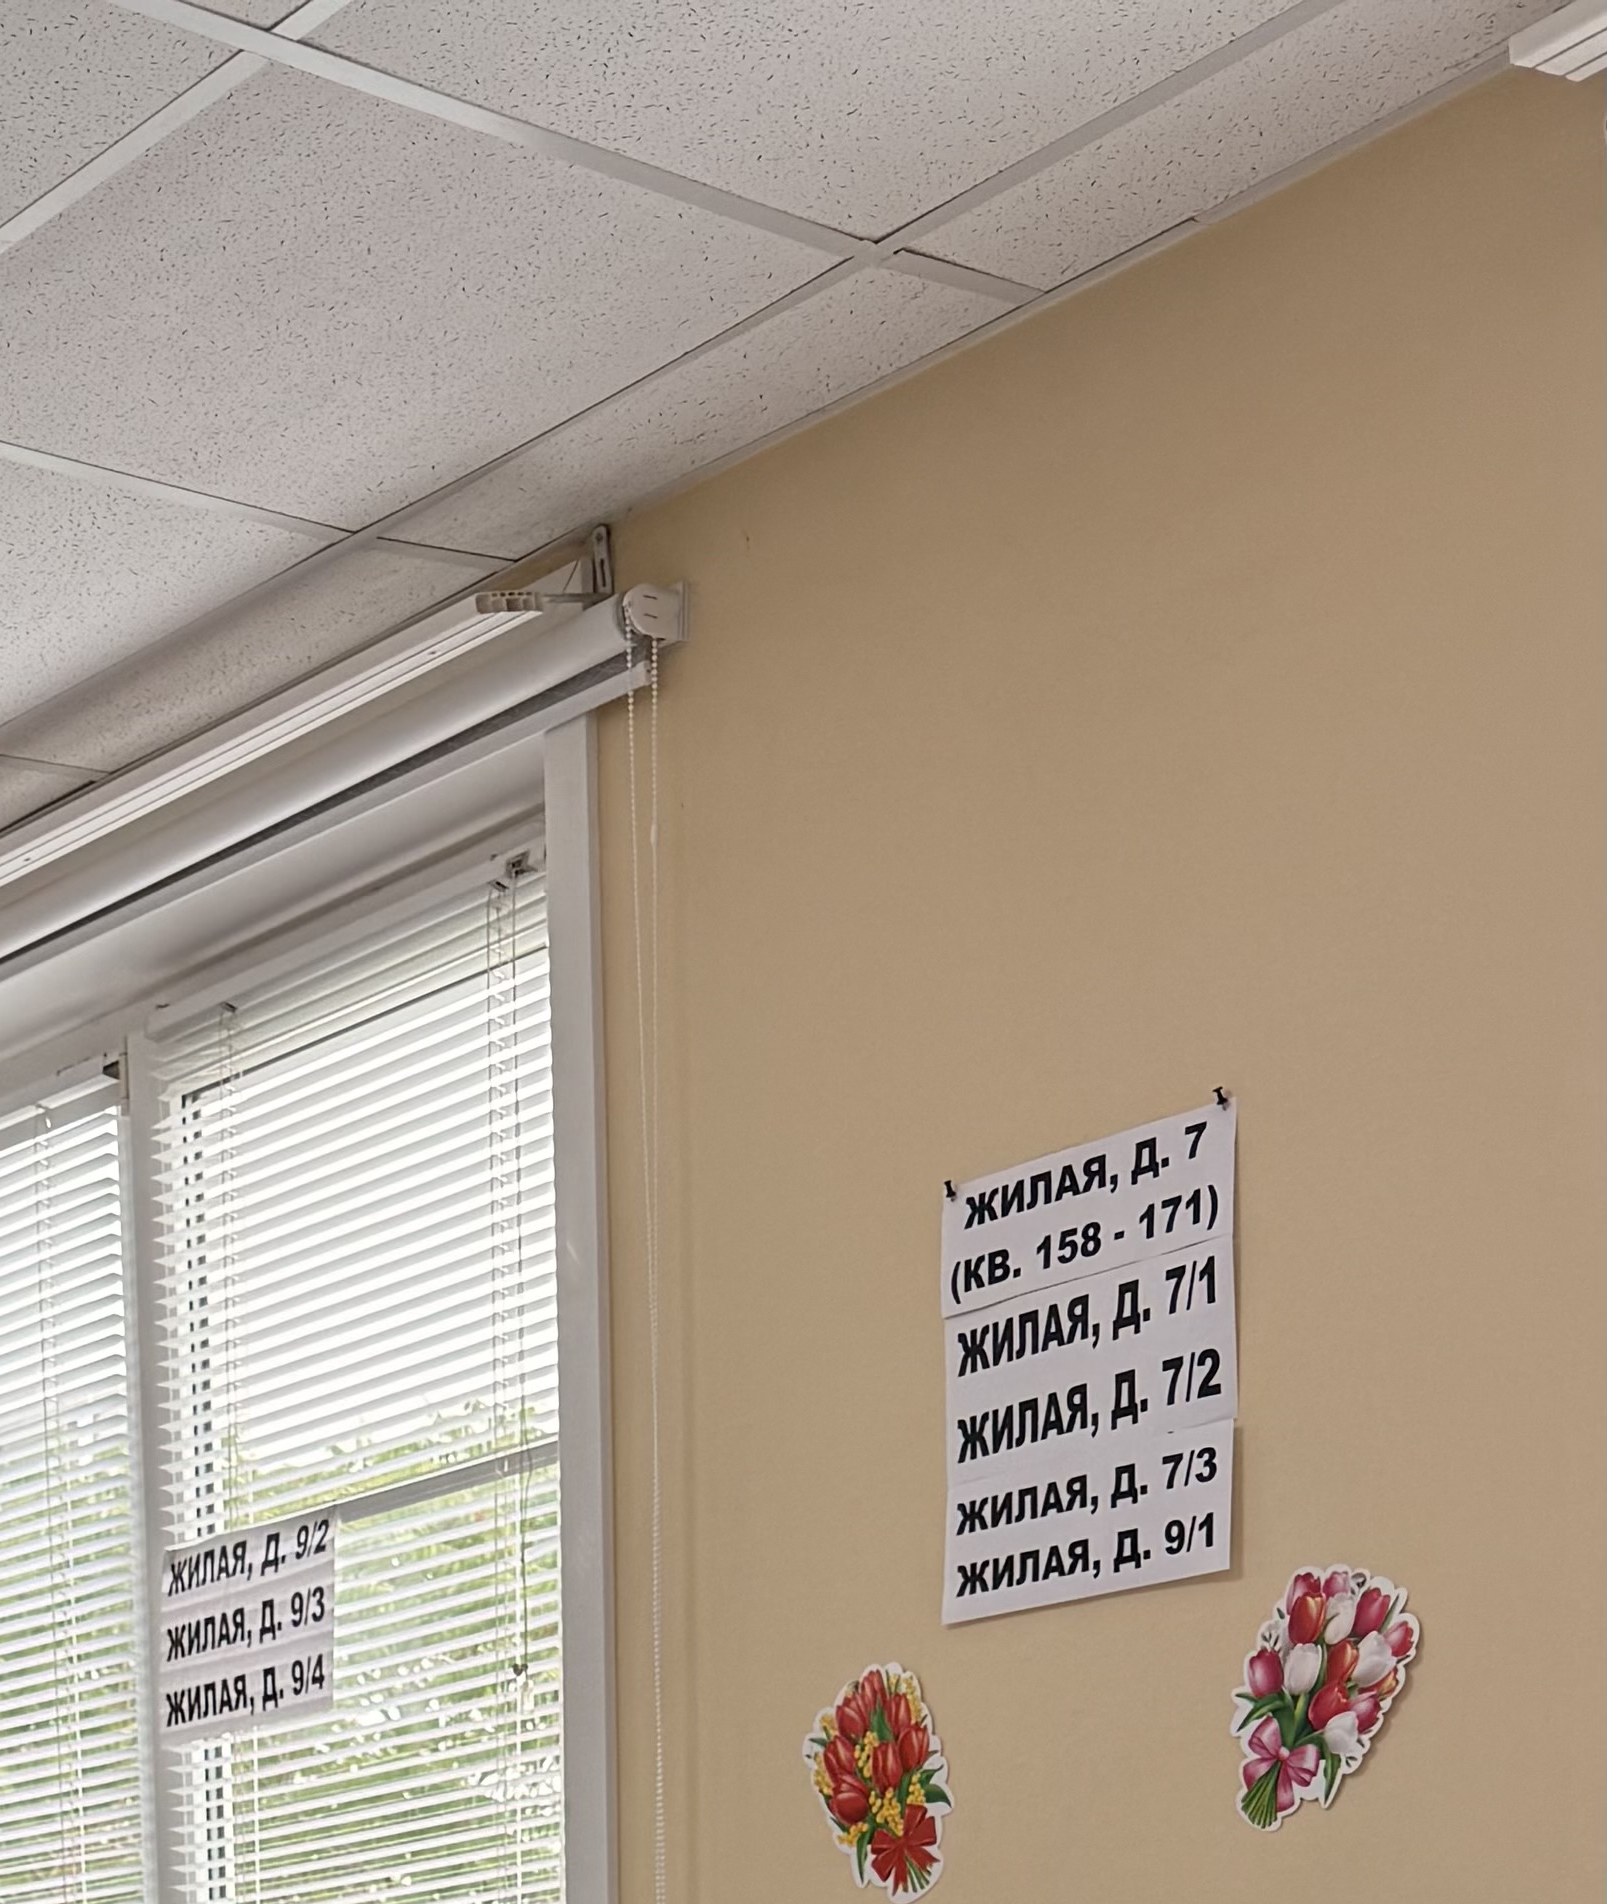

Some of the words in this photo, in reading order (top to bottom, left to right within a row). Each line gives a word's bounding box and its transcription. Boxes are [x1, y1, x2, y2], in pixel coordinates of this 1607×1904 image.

[964, 1153, 1119, 1230] ЖИЛАЯ,
[1130, 1136, 1170, 1186] Д.
[1184, 1121, 1208, 1160] 7
[951, 1248, 1022, 1305] (КВ.
[1036, 1221, 1102, 1270] 158
[1138, 1184, 1219, 1240] 171)
[957, 1293, 1101, 1378] ЖИЛАЯ,
[1112, 1279, 1151, 1341] Д.
[1165, 1255, 1216, 1315] 7/1
[957, 1383, 1099, 1464] ЖИЛАЯ,
[1110, 1368, 1148, 1431] Д.
[1162, 1348, 1222, 1406] 7/2
[956, 1474, 1099, 1536] ЖИЛАЯ,
[1110, 1463, 1148, 1509] Д.
[1161, 1446, 1218, 1490] 7/3
[167, 1540, 253, 1597] ЖИЛАЯ,
[260, 1532, 287, 1577] Д.
[295, 1518, 330, 1560] 9/2
[956, 1538, 1101, 1598] ЖИЛАЯ,
[1113, 1527, 1151, 1574] Д.
[1164, 1512, 1214, 1555] 9/1
[166, 1607, 252, 1662] ЖИЛАЯ,
[259, 1598, 283, 1644] Д.
[290, 1586, 325, 1628] 9/3
[165, 1674, 255, 1727] ЖИЛАЯ,
[262, 1666, 284, 1712] Д.
[291, 1653, 325, 1696] 9/4
